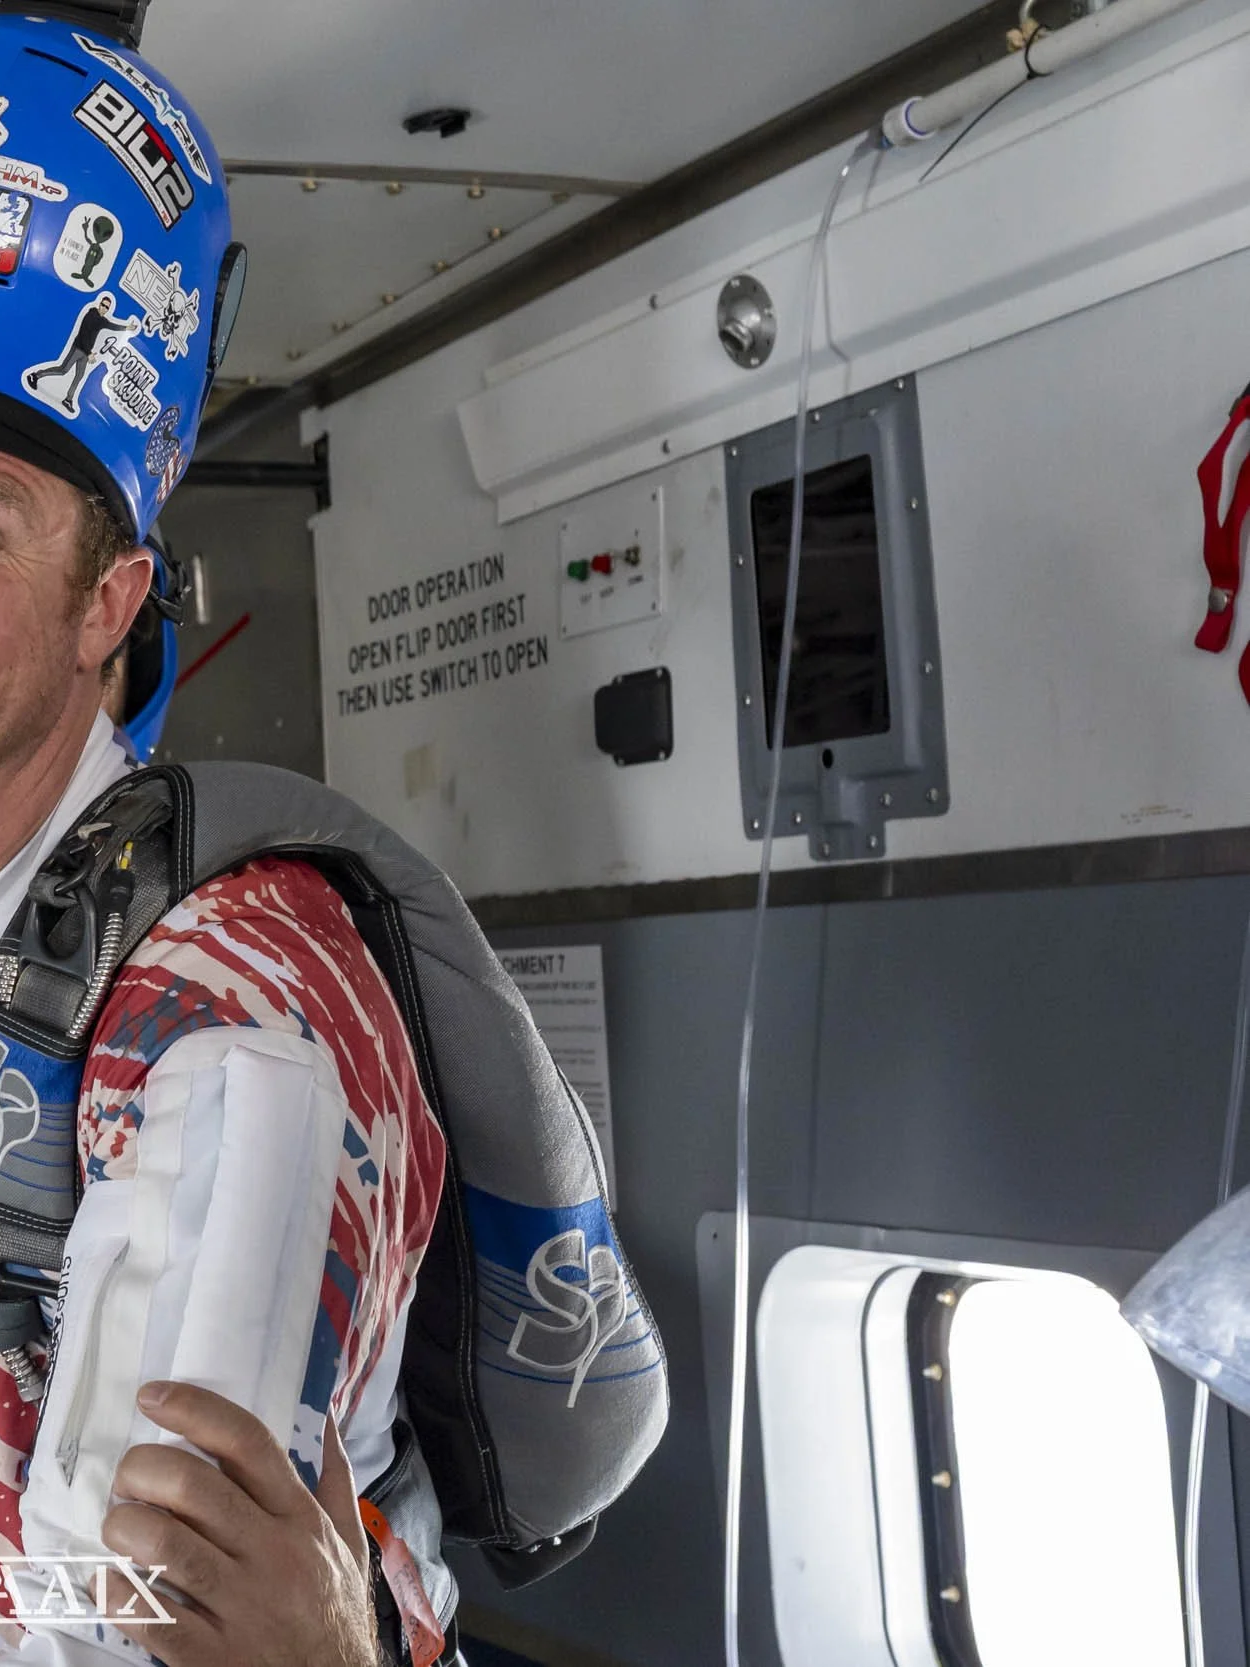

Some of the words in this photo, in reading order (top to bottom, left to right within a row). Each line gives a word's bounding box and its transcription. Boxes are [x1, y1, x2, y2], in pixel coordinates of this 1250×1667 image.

[40, 183, 62, 195] XP
[100, 336, 155, 389] 1-POINT
[109, 370, 159, 426] SKYDIVE
[368, 585, 411, 624] DOOR
[415, 552, 505, 608] OPERATION
[348, 637, 391, 675] OPEN
[395, 625, 431, 664] FLIP
[436, 612, 479, 651] DOOR
[482, 593, 527, 635] FIRST
[338, 678, 378, 717] THEN
[382, 673, 414, 707] USE
[420, 656, 479, 699] SWITCH
[481, 649, 501, 682] TO
[505, 634, 549, 676] OPEN
[503, 953, 554, 975] CHMENT
[558, 953, 565, 974] 7
